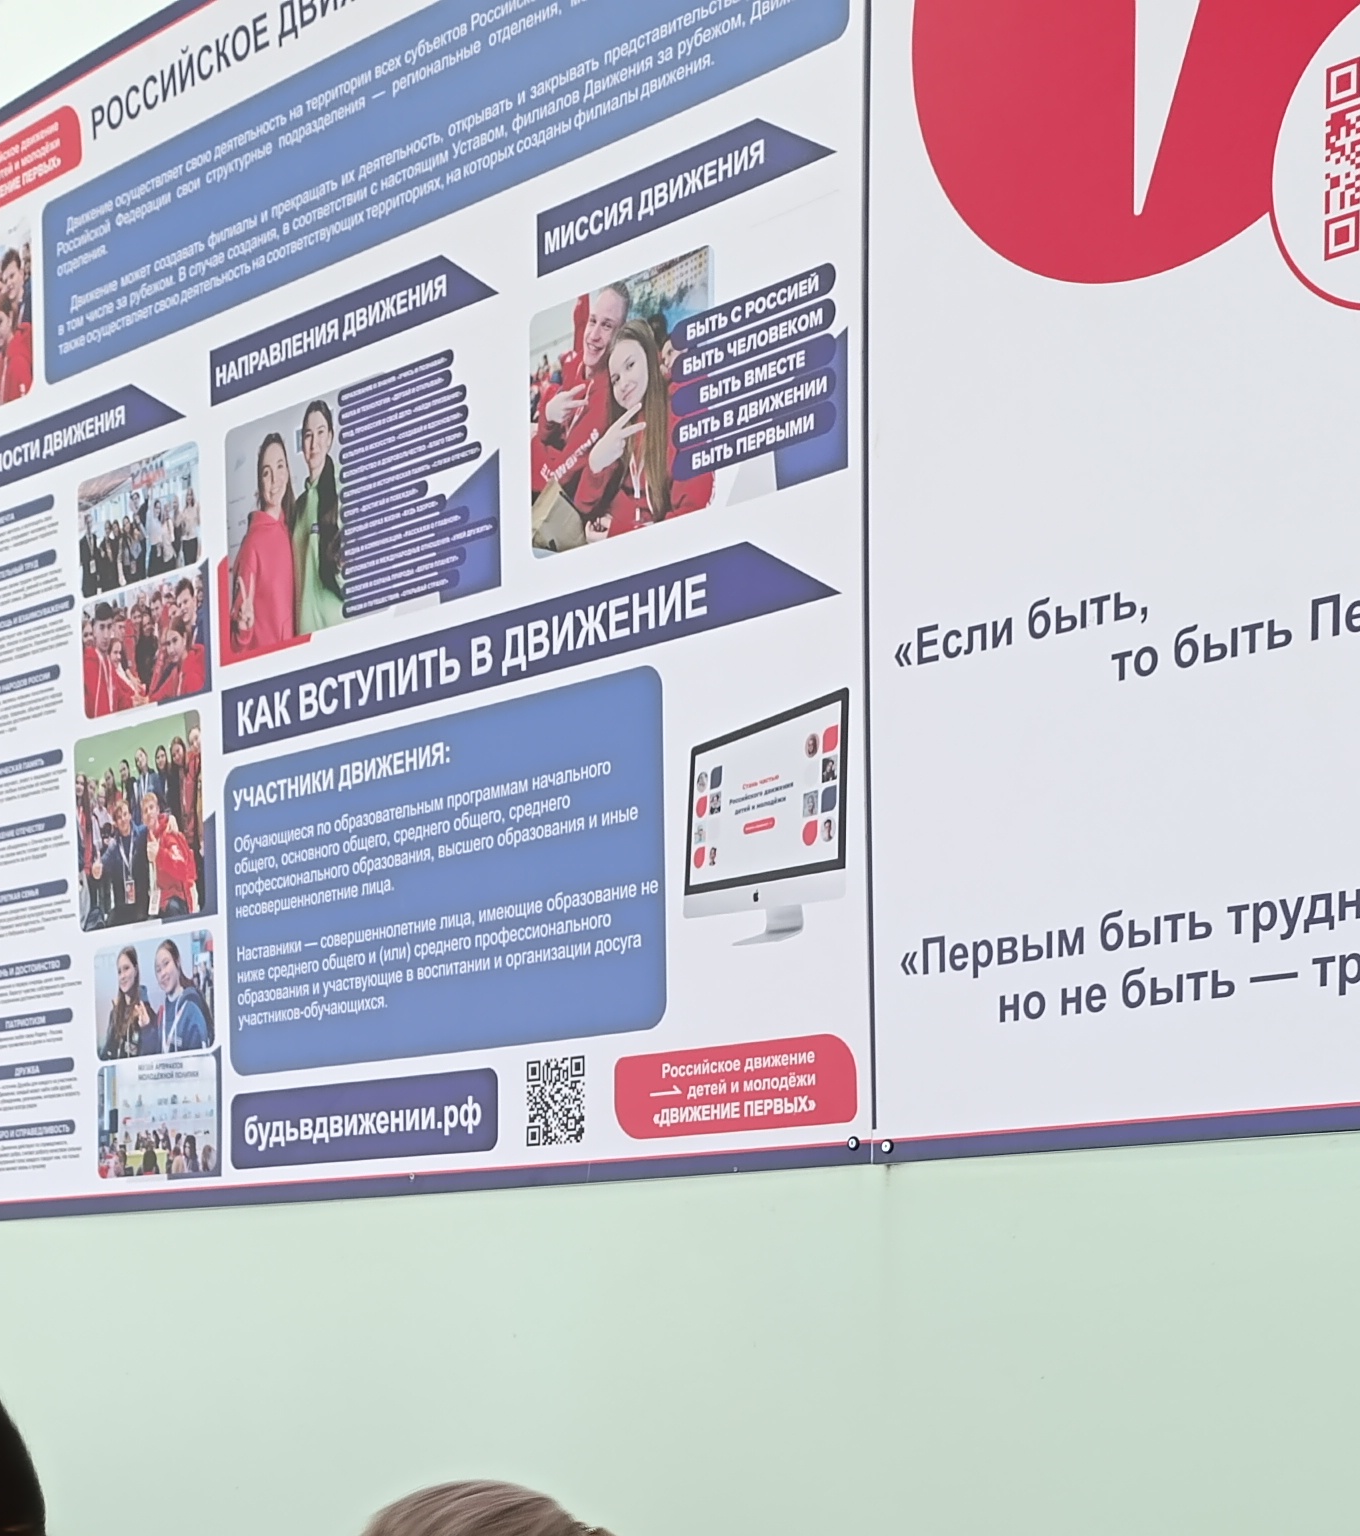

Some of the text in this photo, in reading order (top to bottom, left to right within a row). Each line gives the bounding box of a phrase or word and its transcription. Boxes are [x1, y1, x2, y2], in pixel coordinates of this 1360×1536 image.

[91, 12, 270, 140] РОССИЙСКОЕ
[516, 53, 714, 154] созданы филиалы движения.
[544, 139, 764, 255] МИССИЯ ДВИЖЕНИЯ
[215, 274, 447, 388] НАПРАВЛЕНИЯ ДВИЖЕНИЯ
[686, 272, 819, 341] БЫТЬ С РОССИЕЙ
[683, 308, 823, 375] БЫТЬ ЧЕЛОВЕКОМ
[679, 376, 827, 443] БЫТЬ В ДВИЖЕНИИ
[700, 350, 806, 403] БЫТЬ ВМЕСТЕ
[42, 405, 126, 459] ДВИЖЕНИЯ
[692, 413, 814, 470] БЫТЬ ПЕРВЫМИ
[237, 573, 708, 737] КАК ВСТУПИТЬ В ДВИЖЕНИЕ
[894, 592, 1148, 667] «Если быть,
[1111, 646, 1158, 682] то
[1174, 619, 1292, 668] быть
[232, 742, 450, 811] УЧАСТНИКИ ДВИЖЕНИЯ:
[234, 761, 612, 854] Обучающиеся по образовательным программам начального
[234, 795, 571, 875] общего, основного общего, среднего общего, среднего
[235, 806, 638, 899] профессионального образования, высшего образования и иные
[235, 878, 394, 918] несовершеннолетние лица.
[900, 926, 1084, 979] «Первым
[1100, 910, 1212, 952] быть
[5, 1016, 46, 1029] ПАТРИОТИЗМ
[999, 990, 1046, 1023] но
[1061, 983, 1107, 1016] не
[1122, 966, 1235, 1009] быть
[14, 1065, 40, 1077] ДРУЖБА
[662, 1050, 815, 1079] Российское движение
[686, 1072, 816, 1100] детей и молодёжи
[244, 1095, 482, 1152] будьвдвижении.рф
[653, 1095, 816, 1128] «ДВИЖЕНИЕ ПЕРВЫХ»
